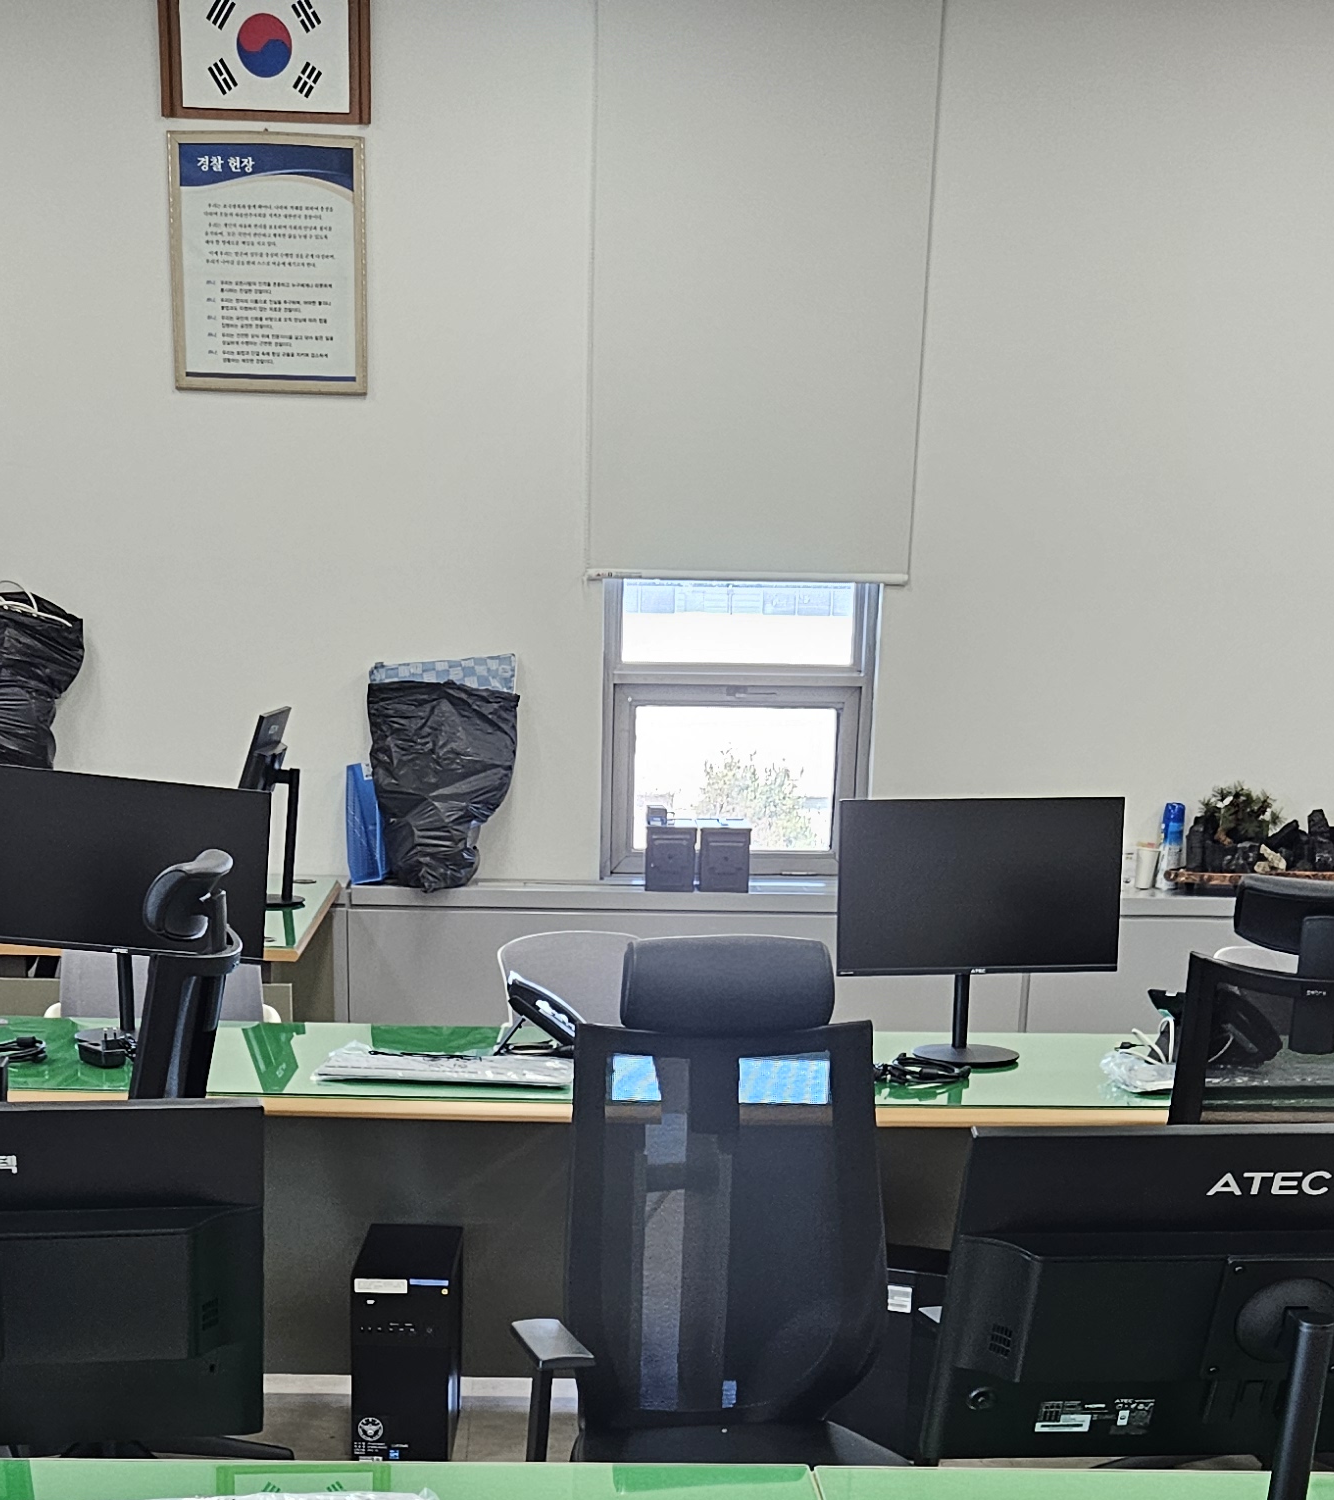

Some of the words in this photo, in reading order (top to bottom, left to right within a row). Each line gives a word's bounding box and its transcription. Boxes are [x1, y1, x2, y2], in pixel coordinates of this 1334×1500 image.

[196, 155, 224, 172] 경찰
[227, 156, 255, 173] 헌장
[1205, 1170, 1333, 1196] ATEC
